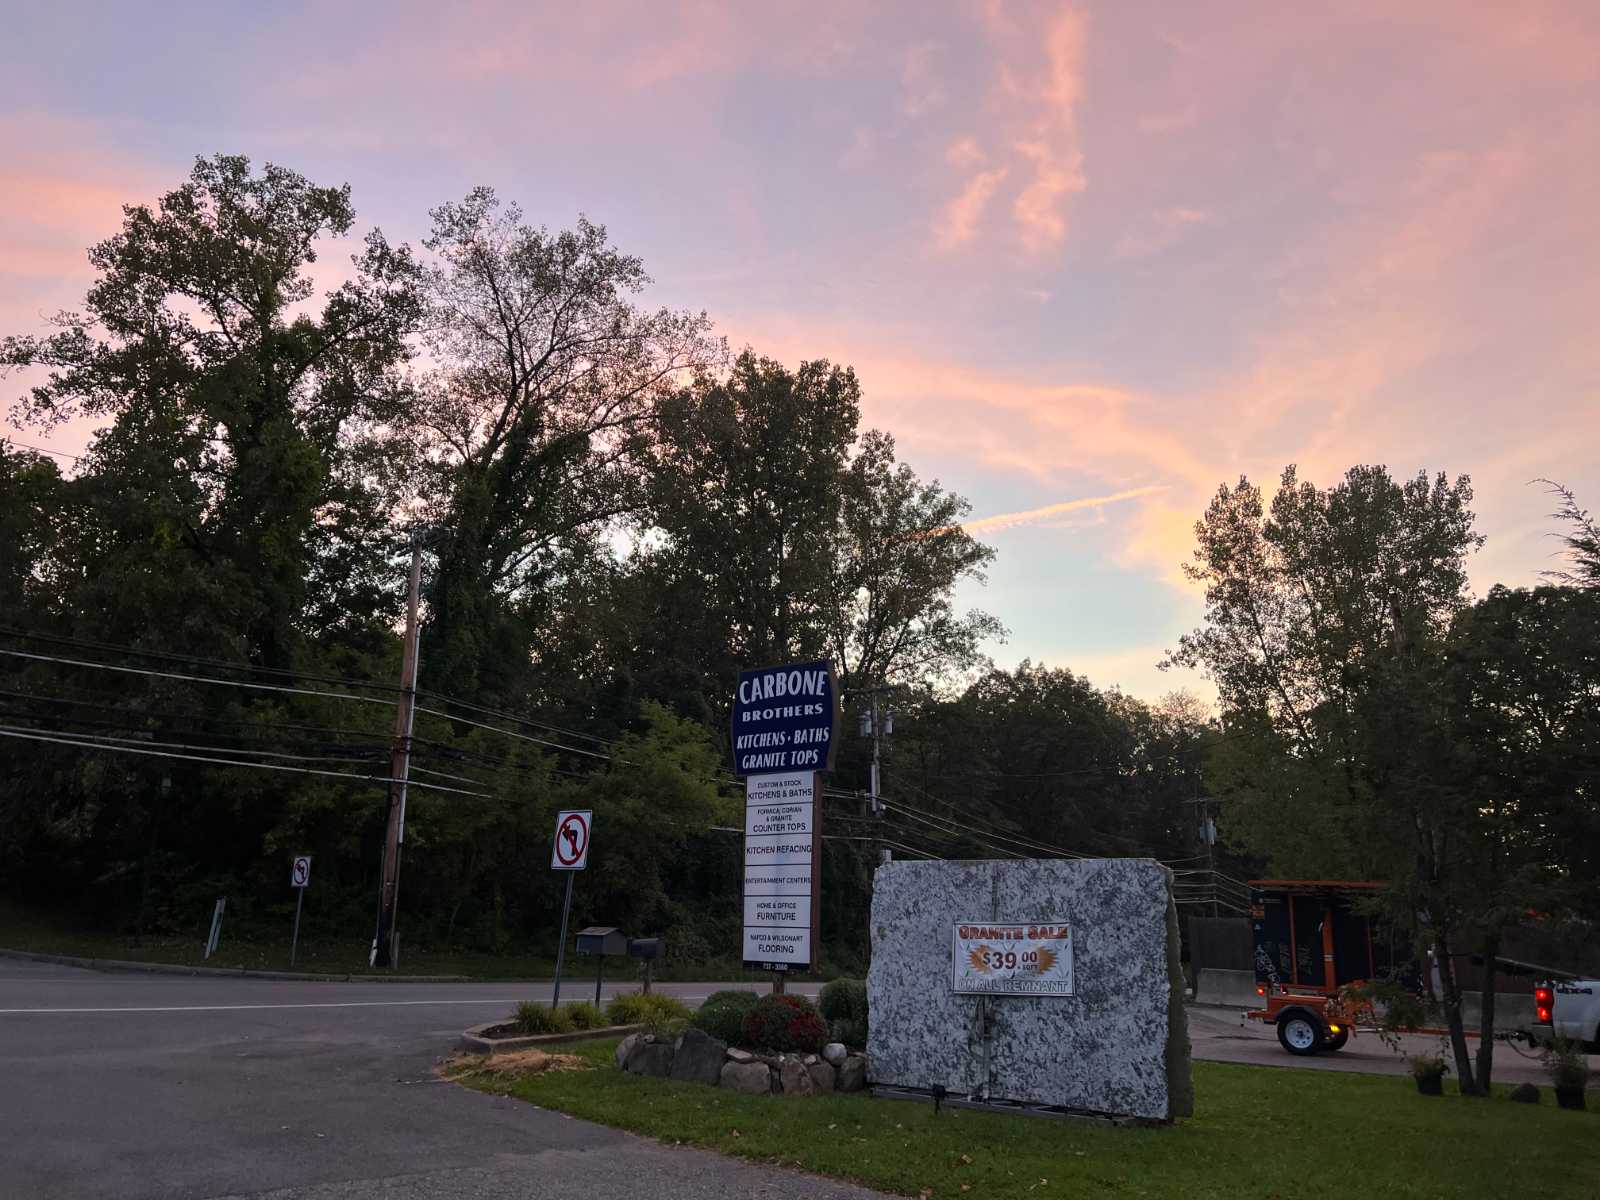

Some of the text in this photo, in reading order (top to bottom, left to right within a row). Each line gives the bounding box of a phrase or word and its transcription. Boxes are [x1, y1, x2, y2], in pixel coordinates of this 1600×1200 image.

[740, 670, 828, 704] CARBONE
[742, 703, 823, 722] BROTHERS
[737, 727, 830, 749] KITCHENS BATHS
[742, 749, 819, 769] GRANITE TOPS
[748, 790, 780, 800] KITCHENS
[789, 788, 812, 797] BATHS
[753, 822, 806, 832] COUNTER TOPS
[746, 845, 812, 854] KITCHEN REFACING
[757, 912, 796, 920] FURNITURE
[959, 925, 1068, 940] GRANITE SALE
[758, 944, 794, 953] FLOORING
